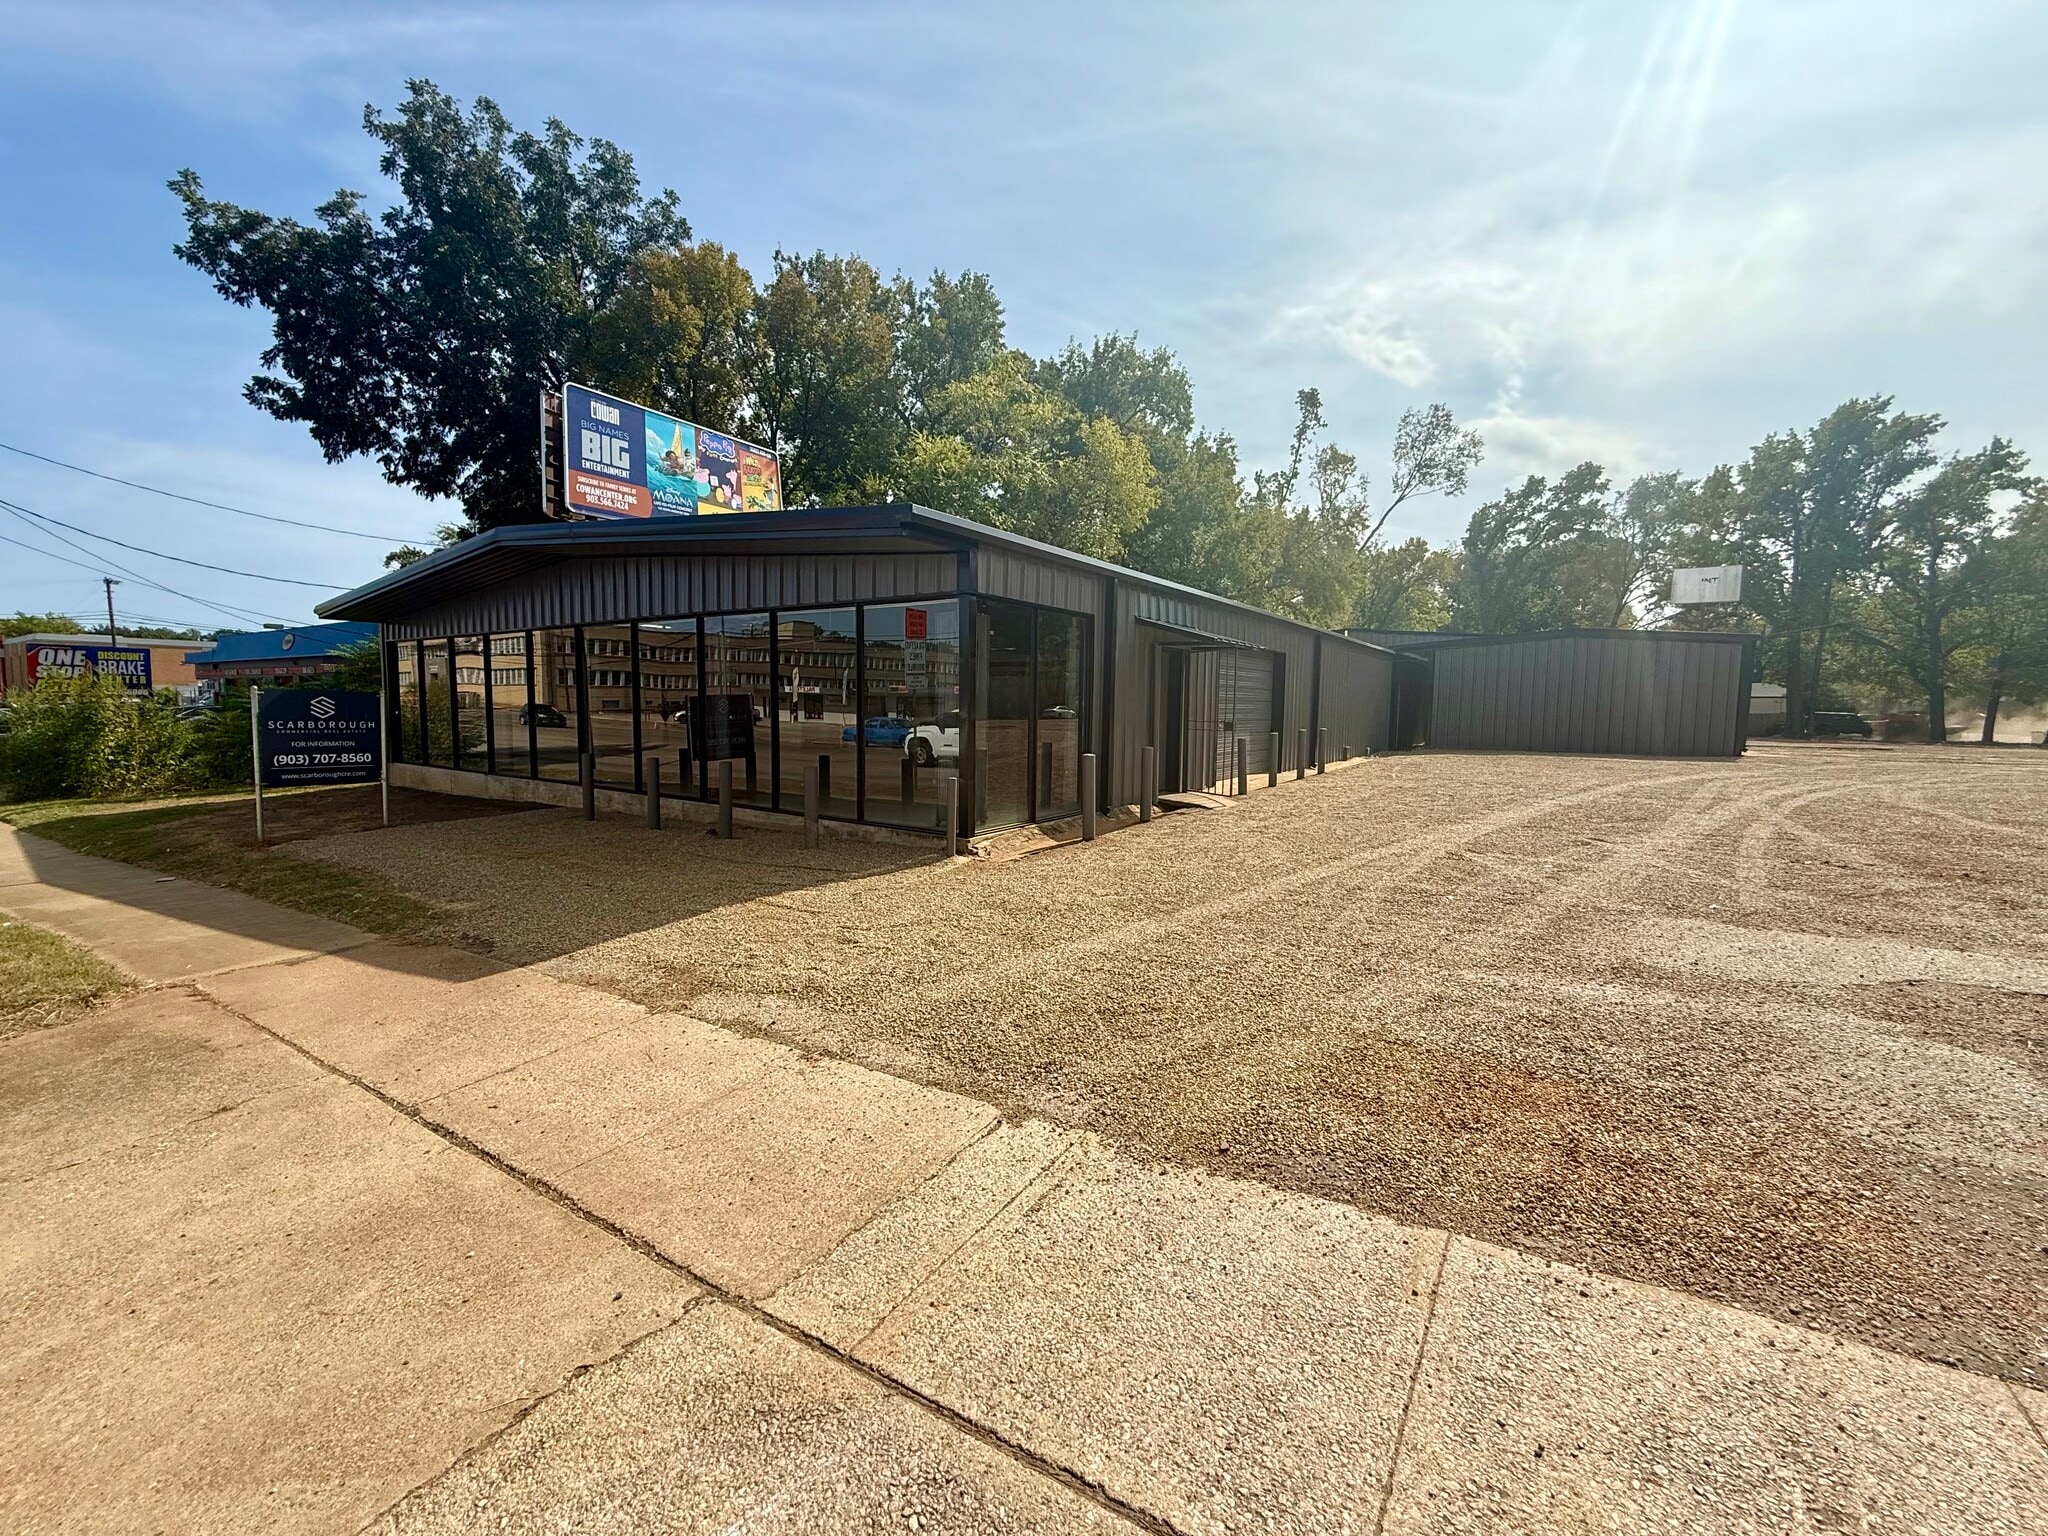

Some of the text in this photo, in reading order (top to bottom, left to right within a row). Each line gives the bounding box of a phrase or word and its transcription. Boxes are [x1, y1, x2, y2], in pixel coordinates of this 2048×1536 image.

[581, 420, 630, 441] BIG NAMES
[581, 429, 630, 470] BIG
[702, 433, 722, 451] Peppa
[722, 440, 733, 456] Pig
[581, 459, 630, 479] ENTERTAINMENT
[575, 483, 638, 505] COWANCENTER.ORG
[585, 493, 629, 511] 903.566.7424
[653, 489, 694, 508] MOANA
[37, 648, 87, 666] ONE
[97, 651, 145, 661] DISCOUNT
[98, 660, 146, 675] BRAKE
[268, 720, 376, 729] SCARBOROUGH
[273, 752, 372, 766] (903) 707-8560
[281, 770, 367, 779] www.scarboroughcre.com
